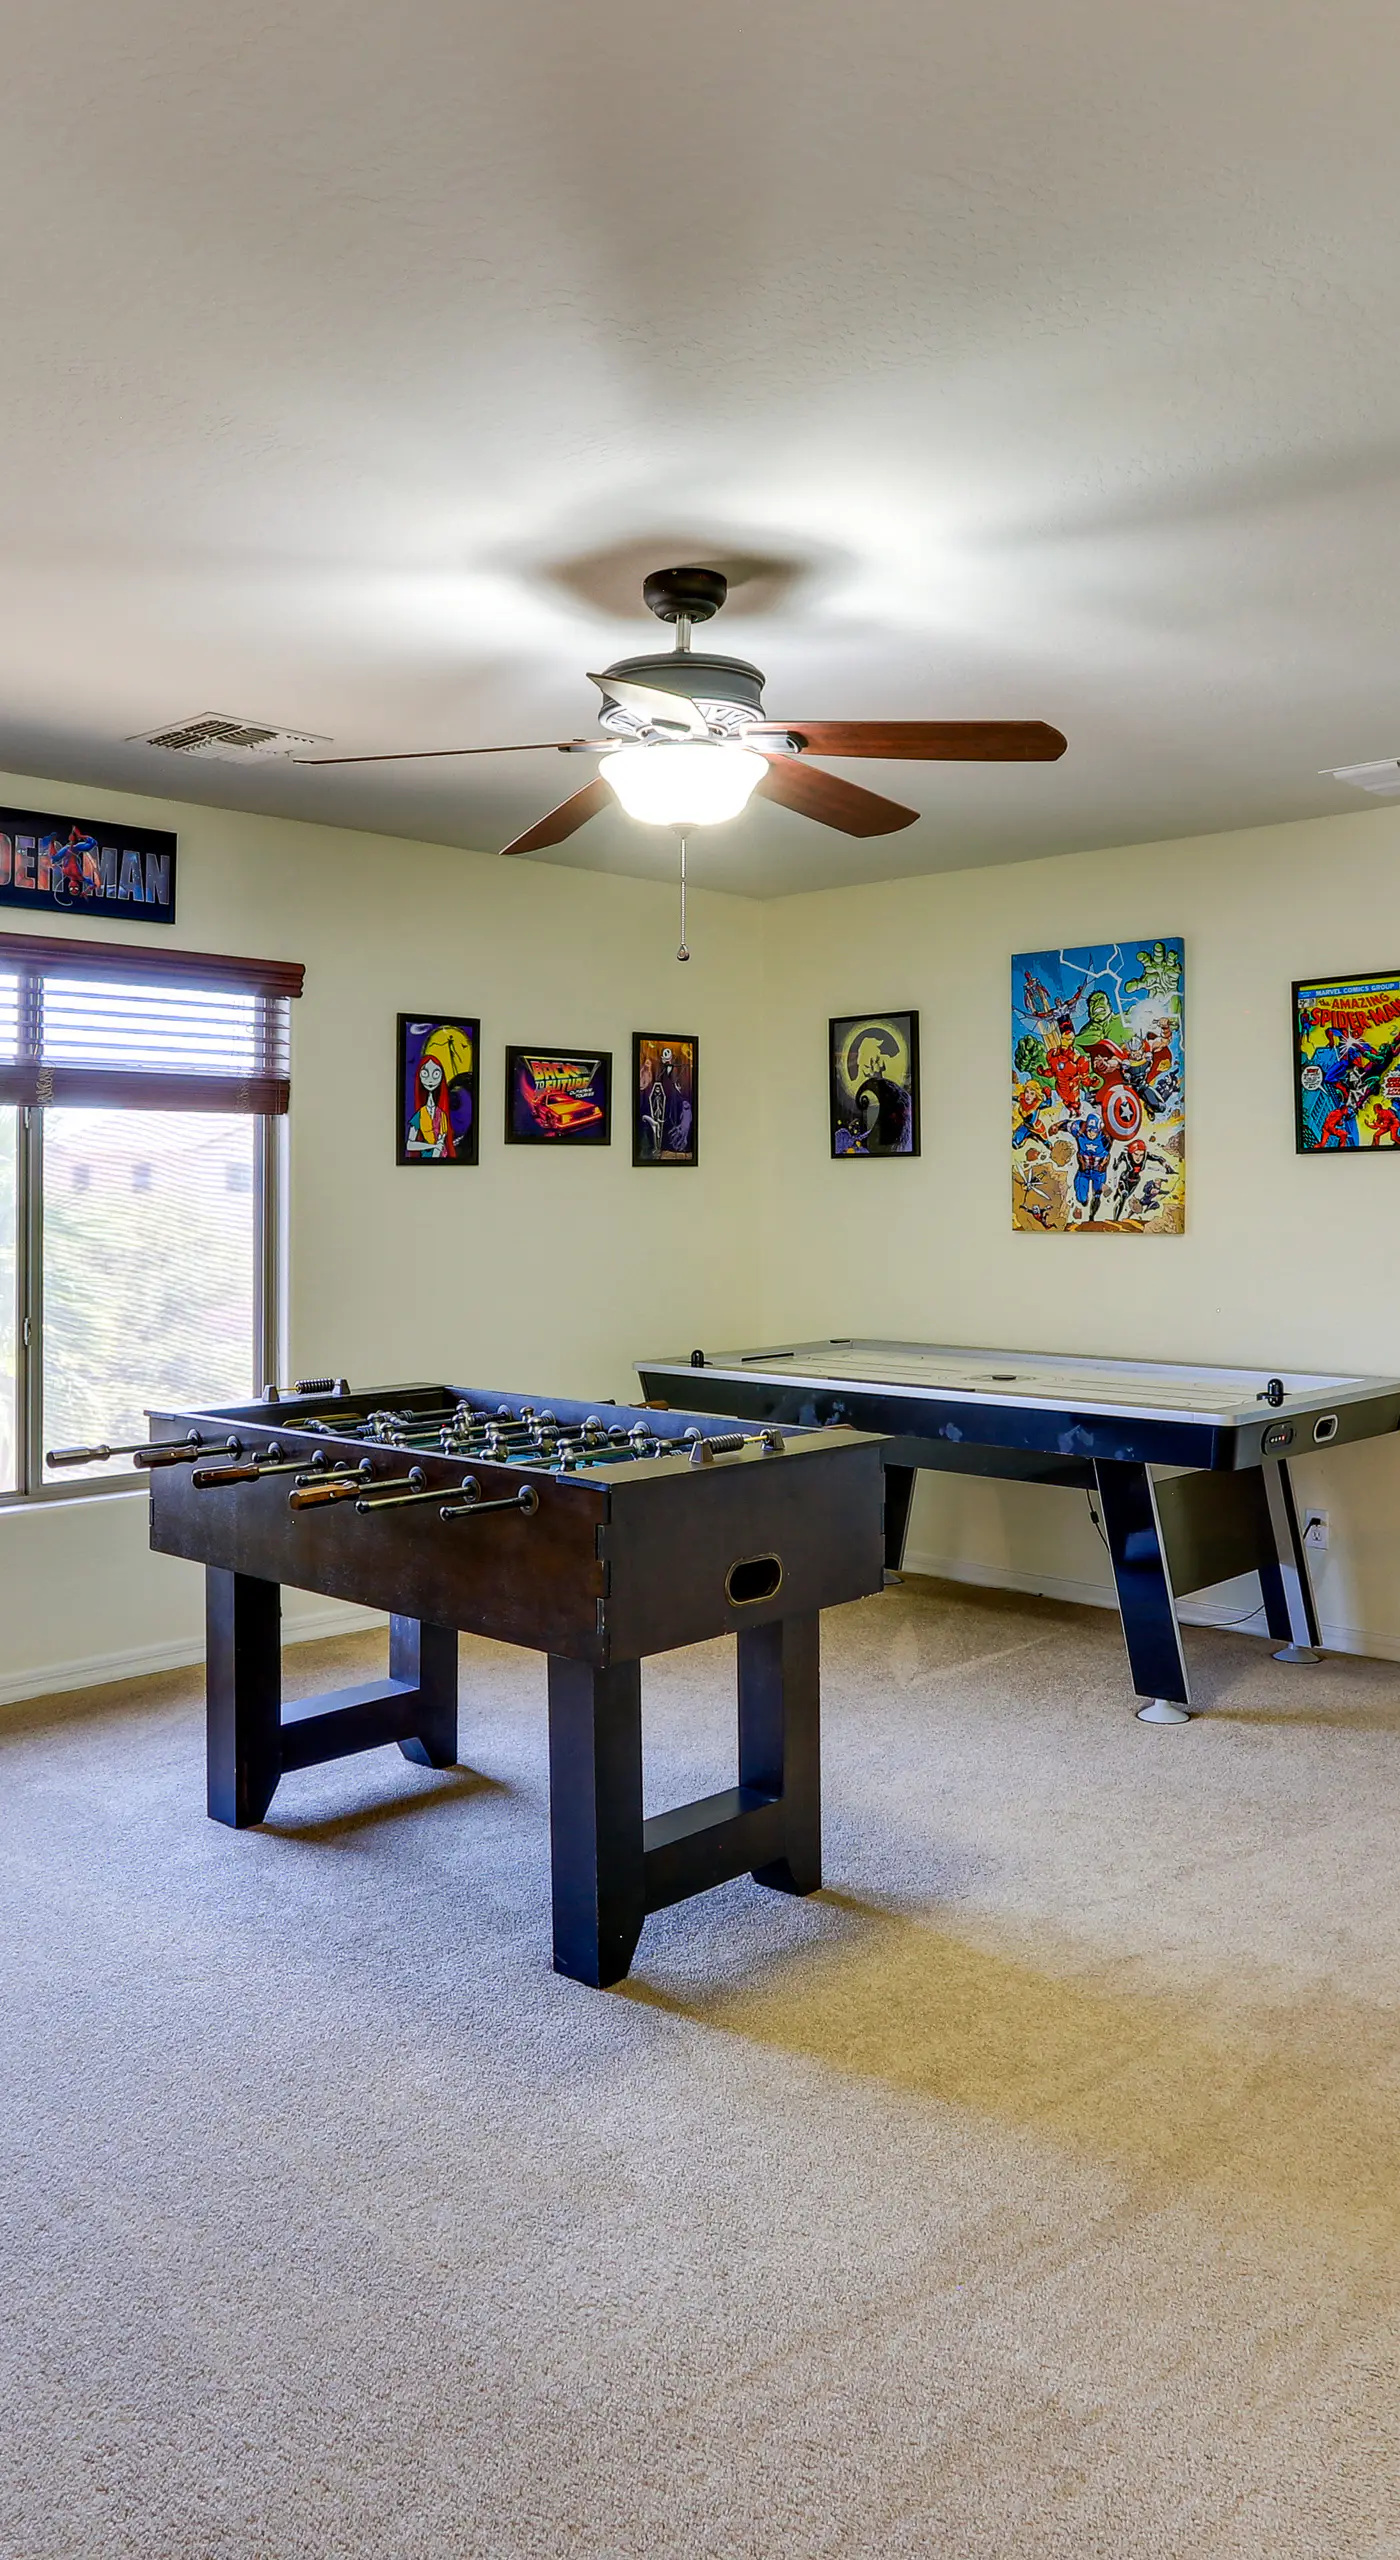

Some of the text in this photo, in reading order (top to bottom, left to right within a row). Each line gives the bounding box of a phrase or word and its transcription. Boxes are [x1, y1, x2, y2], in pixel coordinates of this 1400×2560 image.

[1315, 989, 1342, 997] MARVEL
[1343, 986, 1369, 994] COMICS
[1371, 983, 1395, 991] GROUP
[1331, 993, 1390, 1009] AMAZING
[530, 1060, 582, 1080] BACK
[535, 1080, 545, 1091] TO
[545, 1077, 590, 1092] FUTURE
